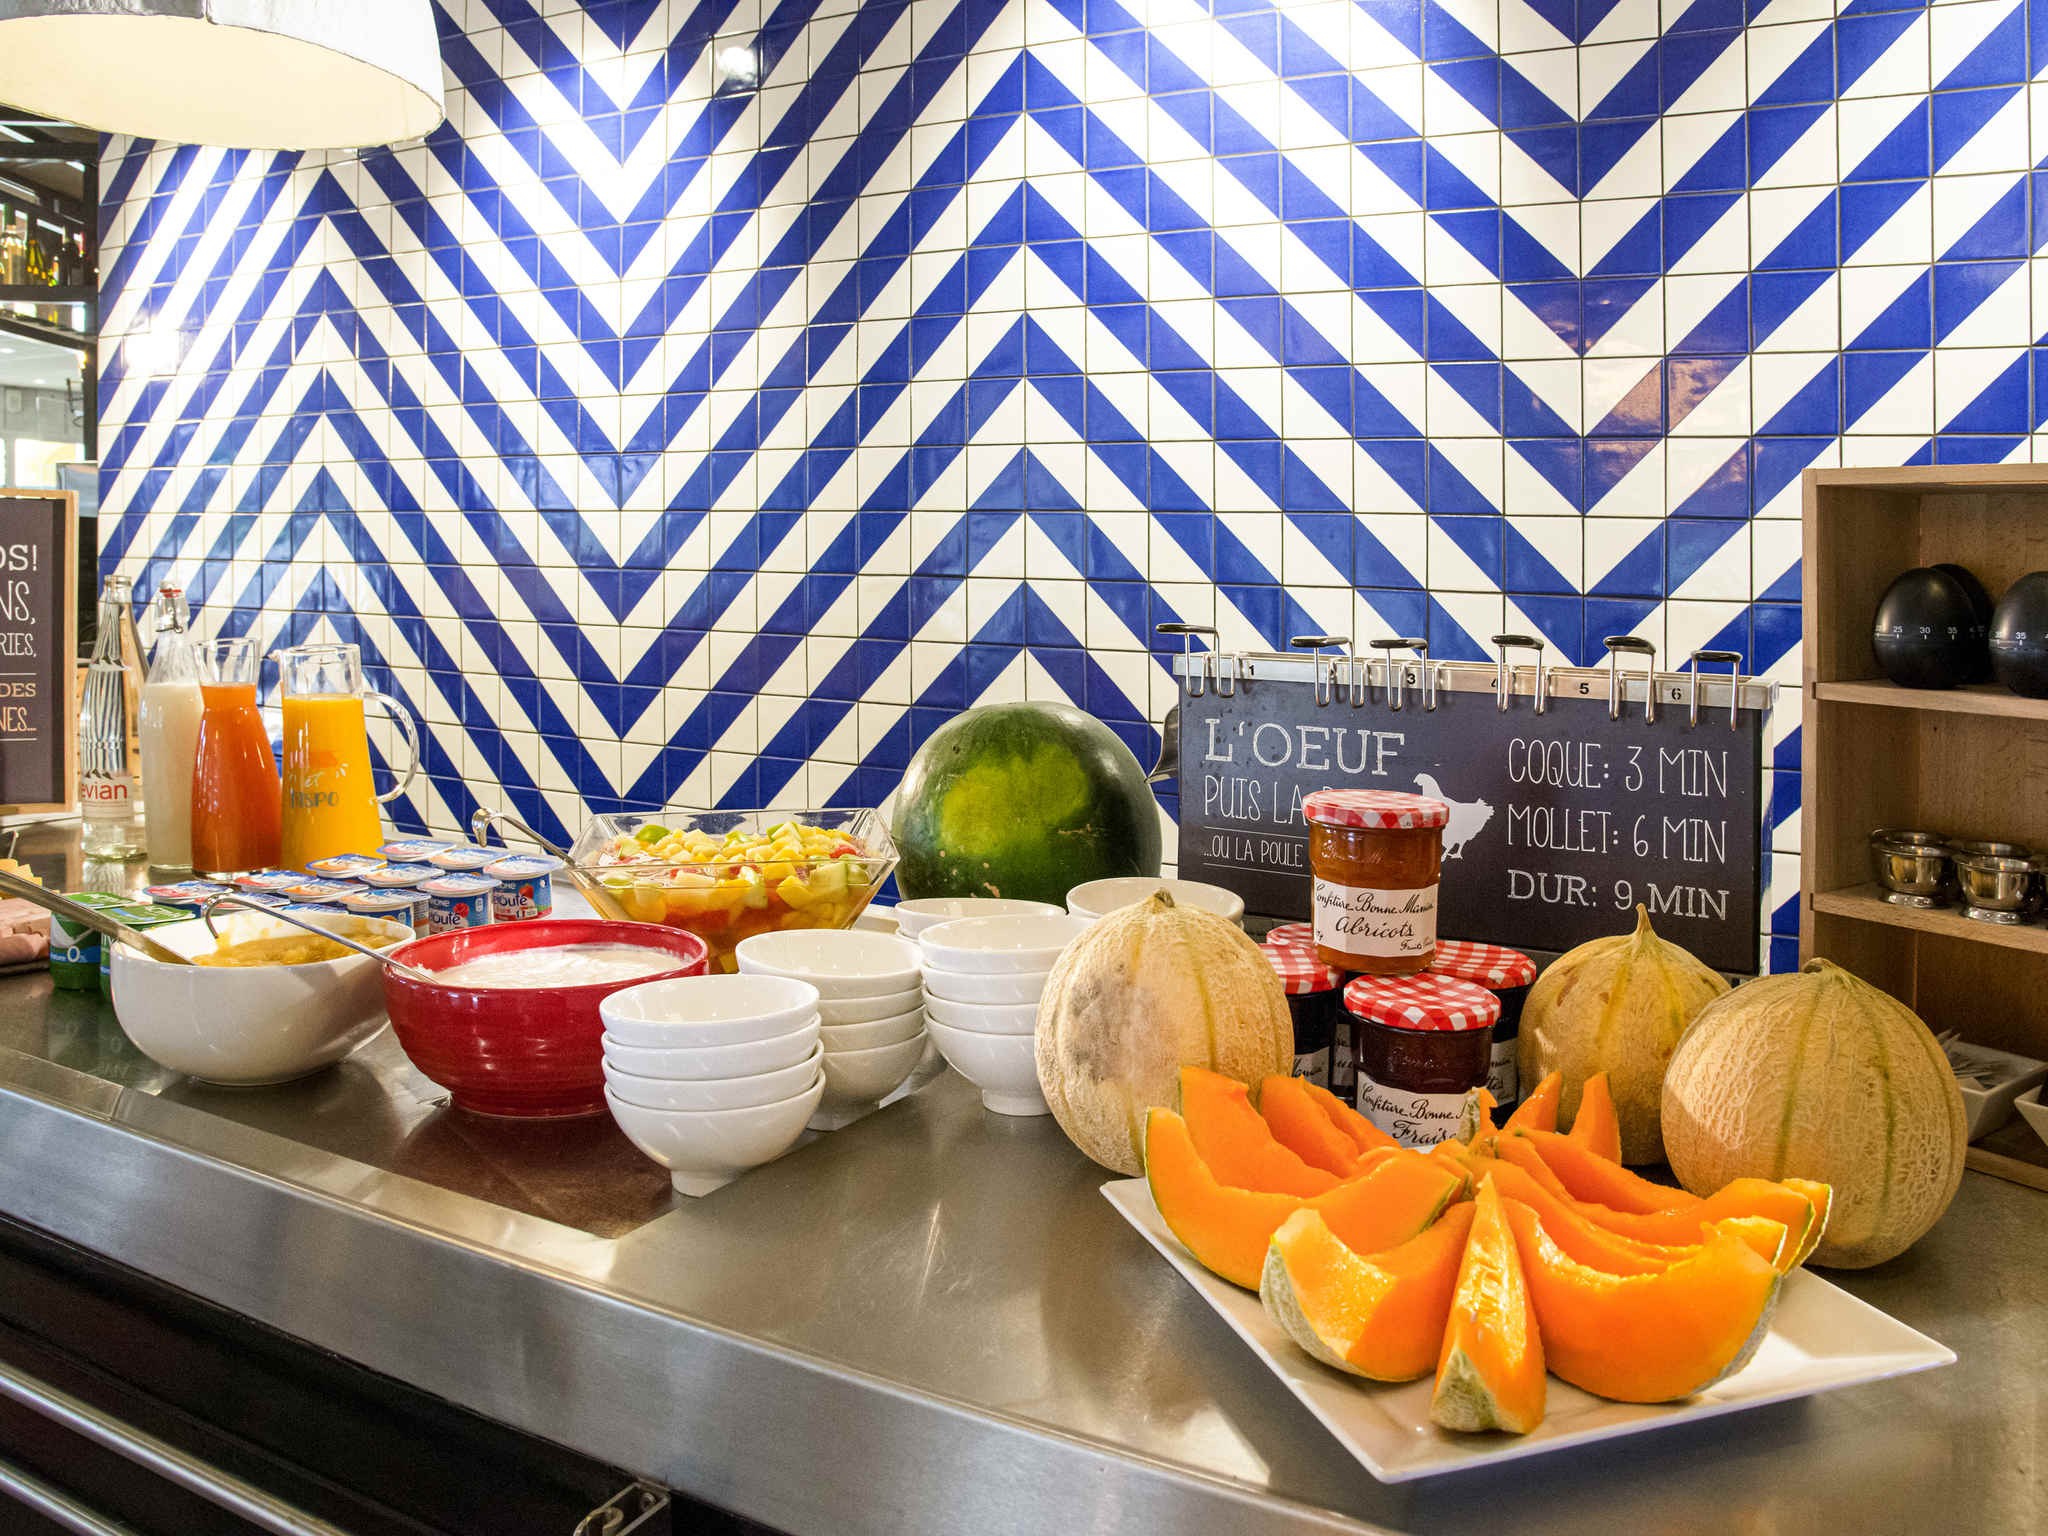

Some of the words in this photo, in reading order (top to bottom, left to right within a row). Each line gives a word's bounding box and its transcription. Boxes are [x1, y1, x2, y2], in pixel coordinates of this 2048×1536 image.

[1920, 626, 1931, 635] 30
[2015, 631, 2026, 640] 35
[1249, 665, 1255, 676] 1
[1407, 673, 1416, 685] 3
[1579, 682, 1589, 695] 5
[1671, 688, 1682, 701] 6
[1204, 718, 1405, 776] L'OEUF
[1508, 738, 1609, 789] COQUE:
[1625, 745, 1643, 792] 3
[1659, 746, 1728, 798] MIN
[1204, 775, 1262, 822] PUIS
[1273, 780, 1308, 826] LA
[1508, 803, 1618, 854] MOLLET:
[1633, 814, 1649, 857] 6
[1663, 816, 1728, 864] MIN
[1236, 838, 1252, 862] LA
[1260, 839, 1303, 868] POULE
[1355, 892, 1398, 914] Bonne
[1507, 869, 1597, 908] DUR:
[1614, 880, 1633, 911] 9
[1647, 882, 1730, 921] MIN
[1335, 916, 1415, 938] Abricots
[1409, 1098, 1453, 1120] Bonne
